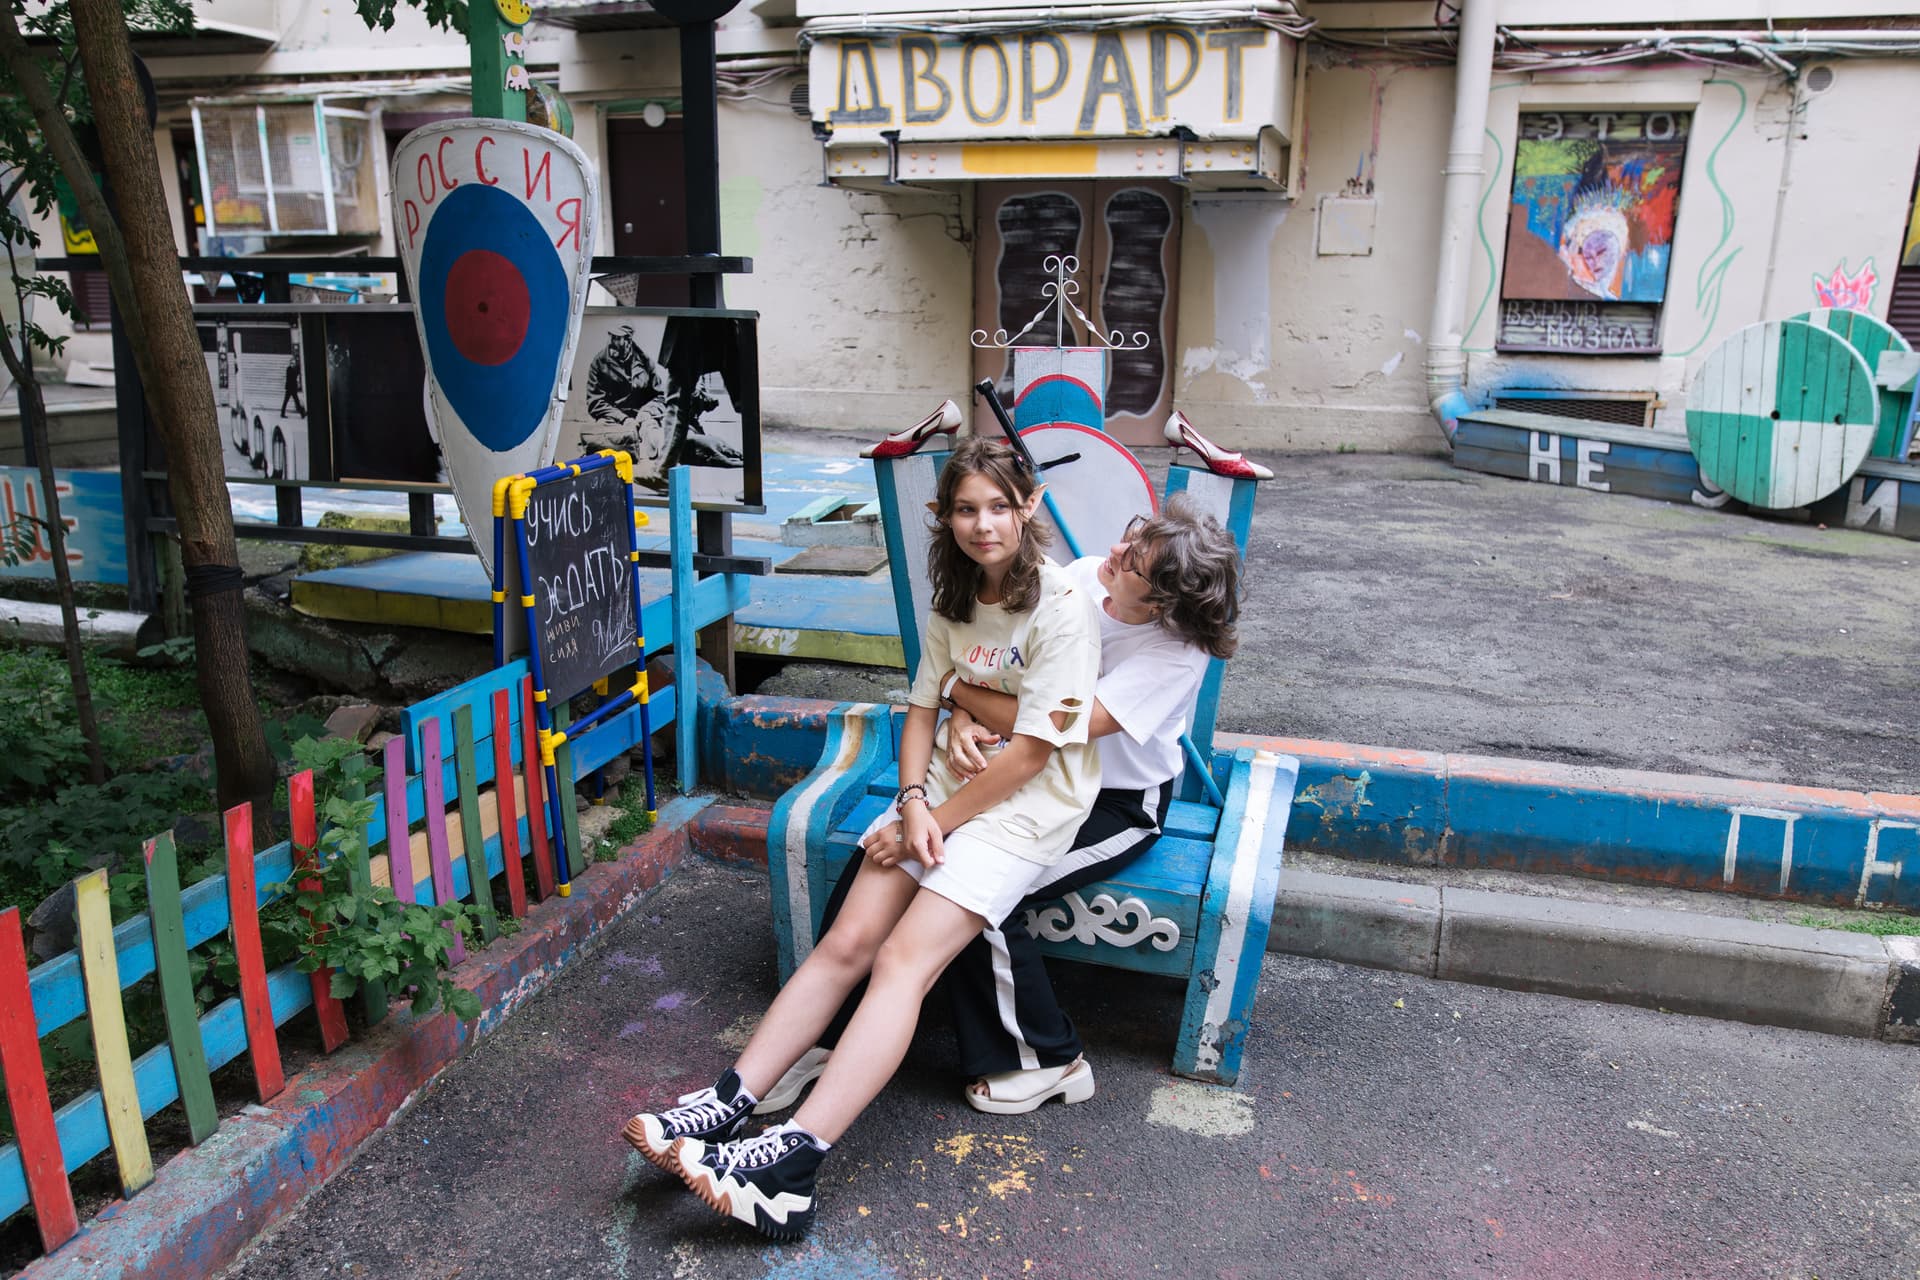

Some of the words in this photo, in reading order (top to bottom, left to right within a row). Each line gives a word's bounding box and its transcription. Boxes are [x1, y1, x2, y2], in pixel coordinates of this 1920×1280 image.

[1537, 112, 1676, 141] ЭТО
[403, 136, 582, 252] РОССИЯ
[1528, 431, 1611, 492] НЕ
[526, 490, 593, 547] УЧИСЬ
[538, 541, 625, 625] ЖДАТЬ
